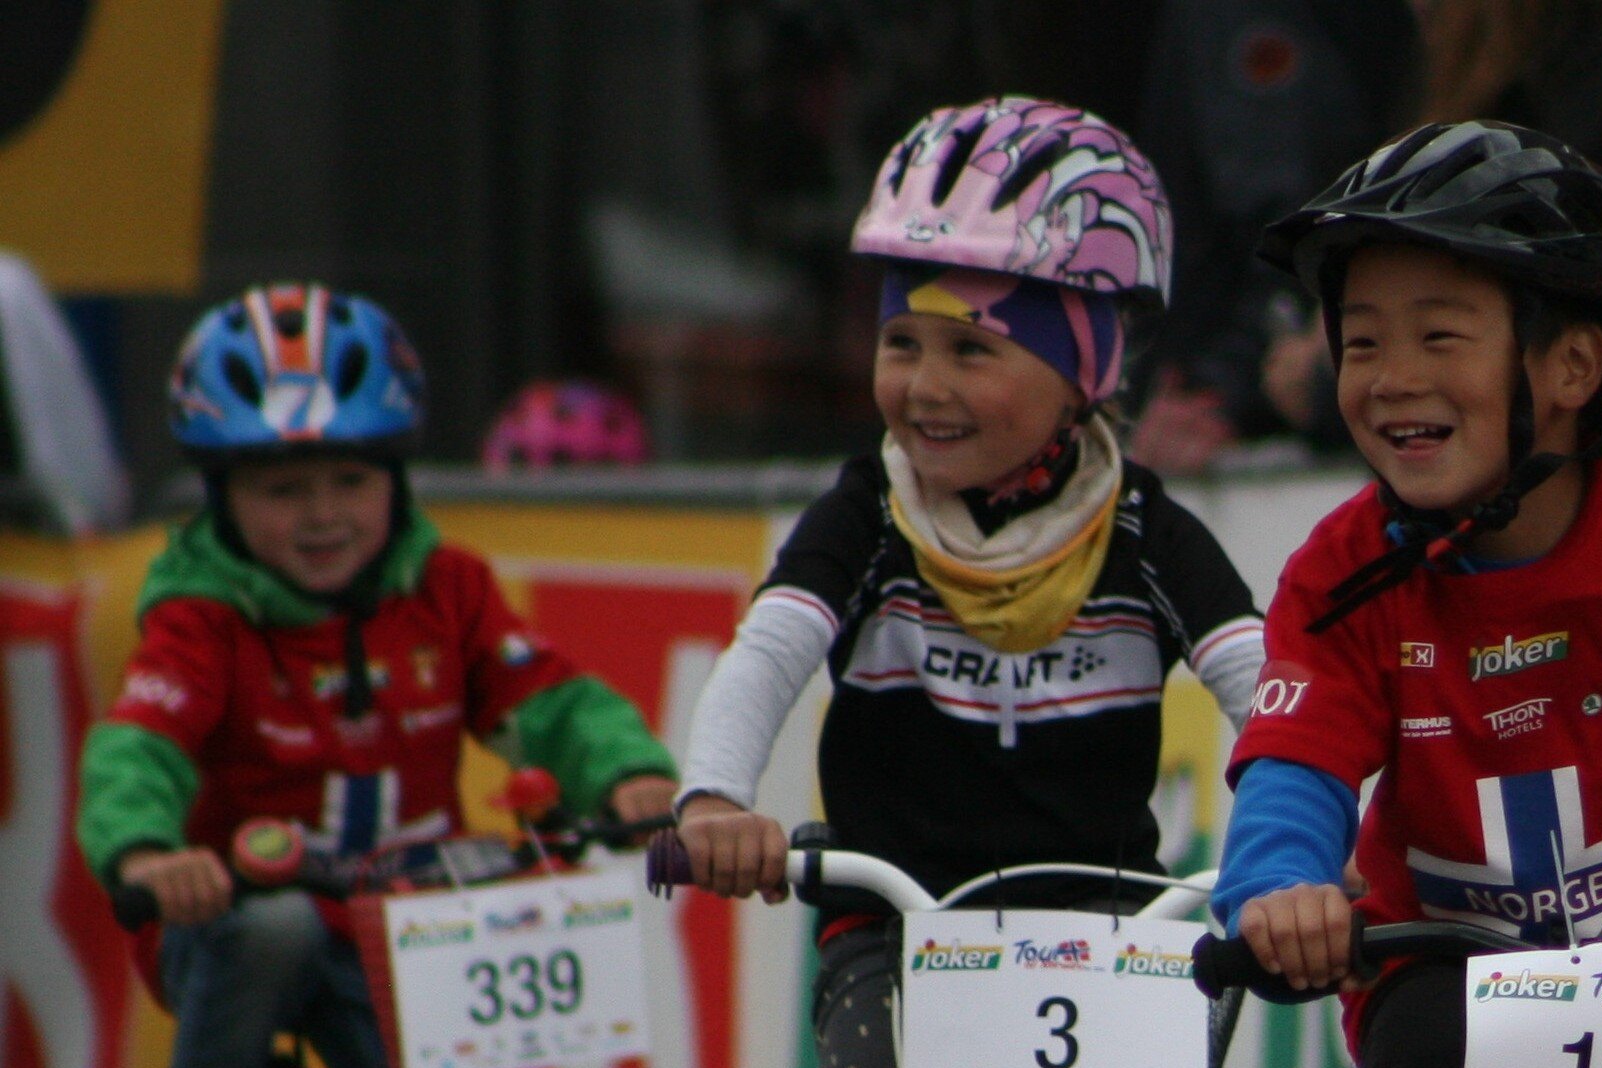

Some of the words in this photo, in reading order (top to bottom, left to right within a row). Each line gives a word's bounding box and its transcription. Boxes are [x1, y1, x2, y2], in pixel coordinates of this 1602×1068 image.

[1471, 634, 1562, 682] joker
[1483, 697, 1552, 731] THON
[1498, 718, 1544, 741] HOTELS
[912, 938, 996, 977] joker
[1114, 943, 1193, 978] joker
[466, 947, 584, 1027] 339
[1477, 968, 1575, 1003] joker
